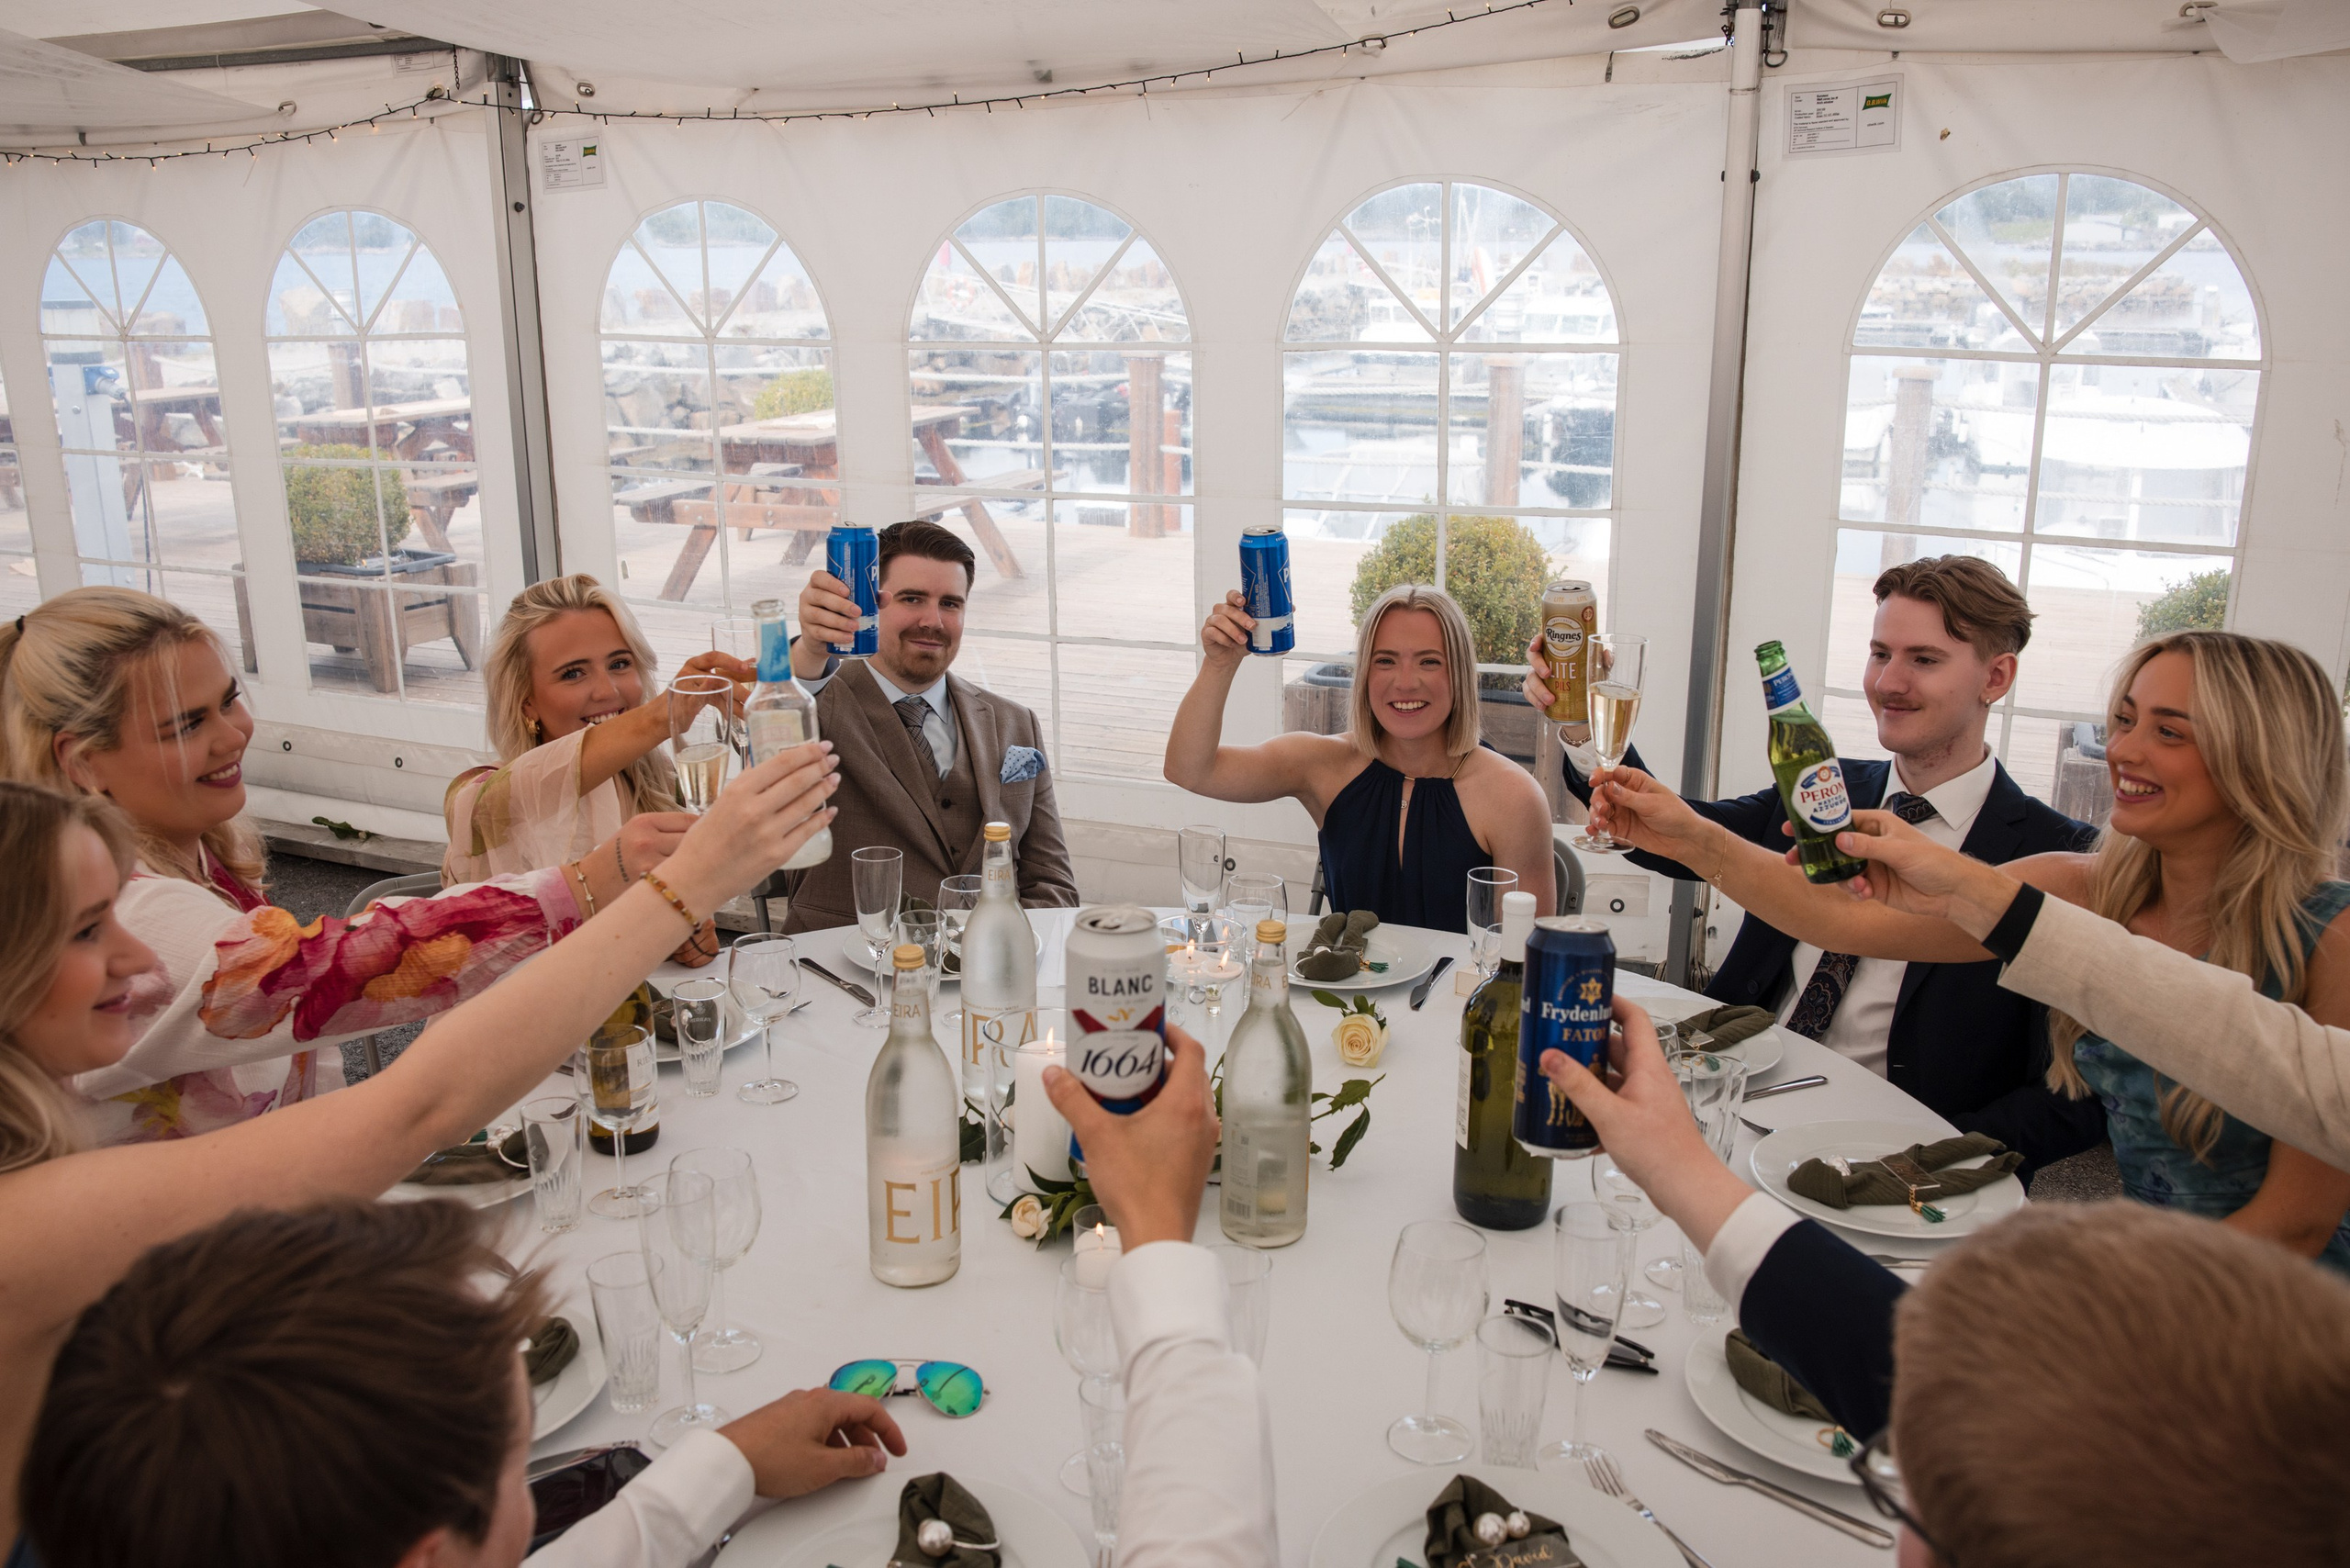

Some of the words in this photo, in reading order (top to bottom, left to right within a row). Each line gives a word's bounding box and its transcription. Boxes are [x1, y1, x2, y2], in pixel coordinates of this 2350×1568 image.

[1546, 628, 1582, 644] Ringnes
[1549, 660, 1577, 679] LITE
[1554, 680, 1572, 692] PILS
[988, 868, 1011, 881] EIRA
[1088, 973, 1153, 997] BLANC
[893, 1002, 921, 1019] EIRA
[1080, 1043, 1159, 1080] 1664
